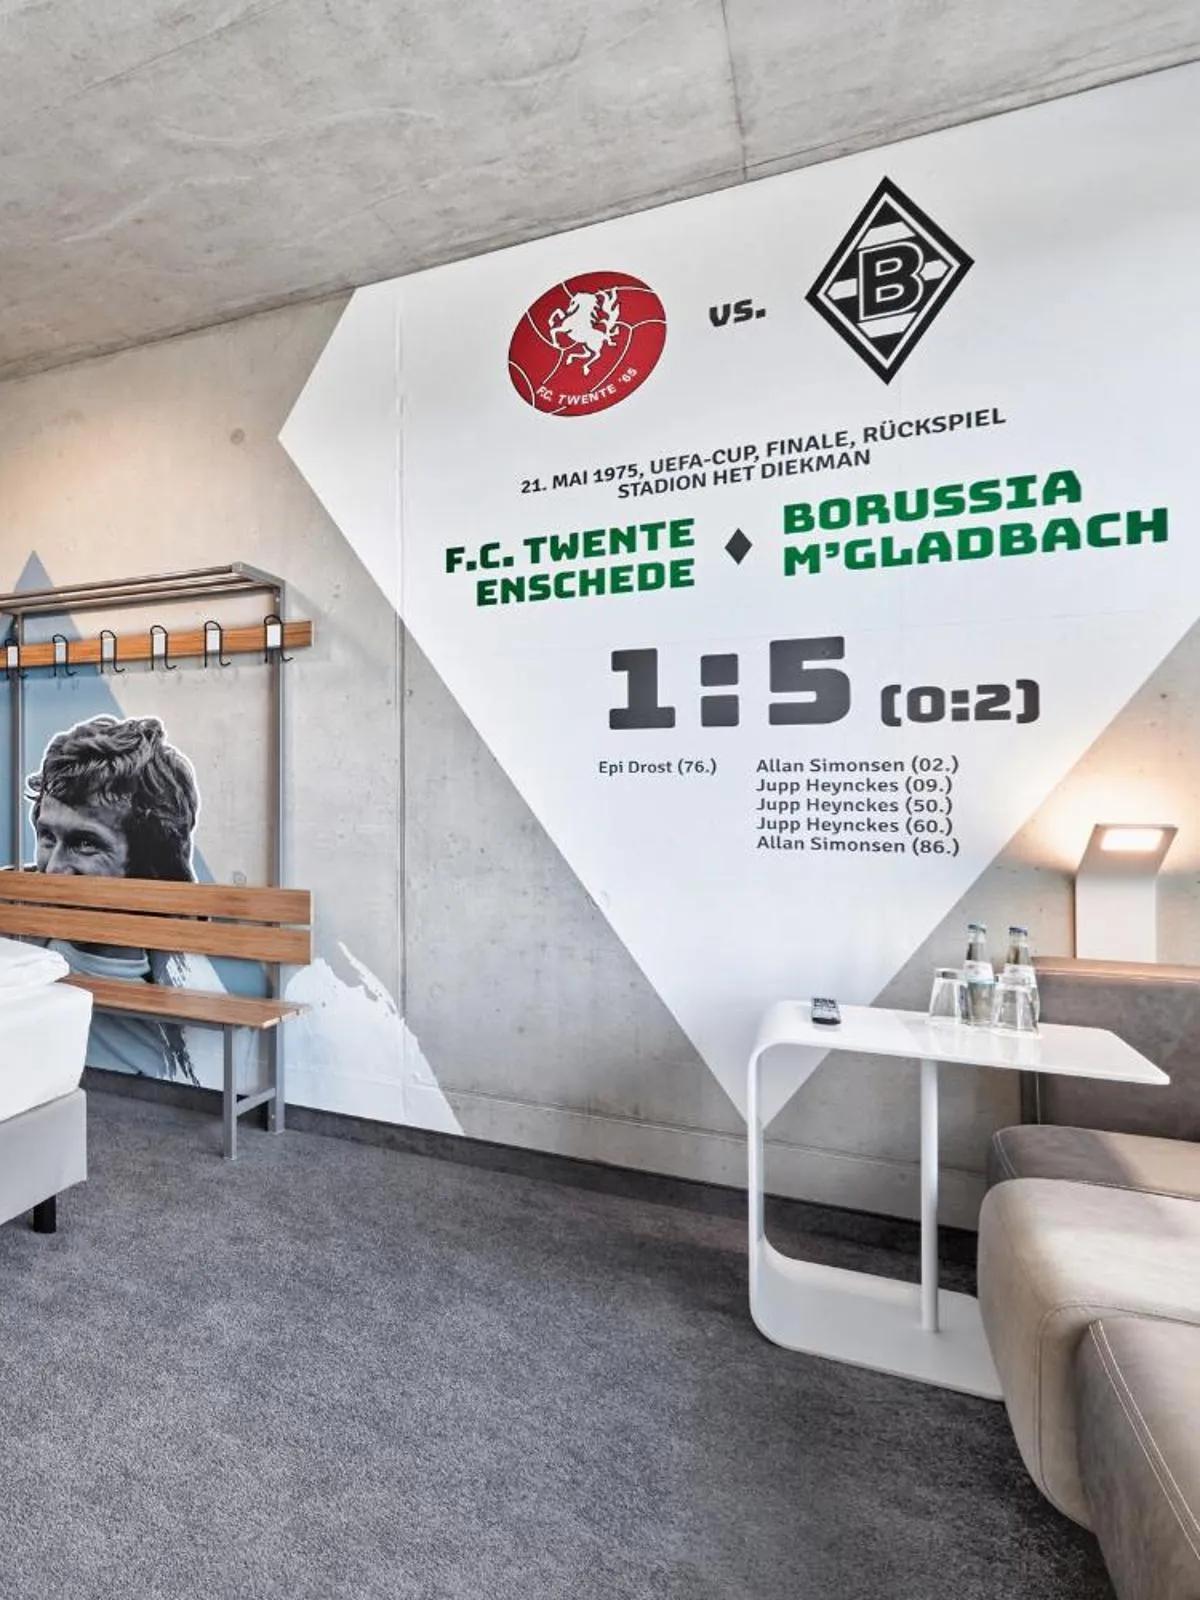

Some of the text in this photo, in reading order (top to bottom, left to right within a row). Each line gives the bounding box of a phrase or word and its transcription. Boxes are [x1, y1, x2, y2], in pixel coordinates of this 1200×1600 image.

[858, 240, 924, 321] B
[558, 383, 617, 405] TWENTE
[520, 407, 1007, 494] 21. MAI 1975, UEFA-CUP, FINALE, RÜCKSPIEL
[617, 449, 871, 499] STADION HET DIEKMAN
[783, 469, 1083, 536] BORUSSIA
[445, 517, 695, 574] F.C. TWENTE
[783, 507, 1169, 577] M'GLADBACH
[476, 557, 695, 607] ENSCHEDE
[880, 678, 1041, 727] (0:2)
[598, 758, 718, 776] Epi Drost (76.)
[756, 755, 960, 775] Allan Simonsen (02.)
[756, 775, 953, 796] Jupp Heynckes (09.)
[756, 795, 953, 816] Jupp Heynckes (50.)
[756, 816, 953, 836] Jupp Heynckes (60.)
[756, 834, 960, 857] Allan Simonsen (86.)
